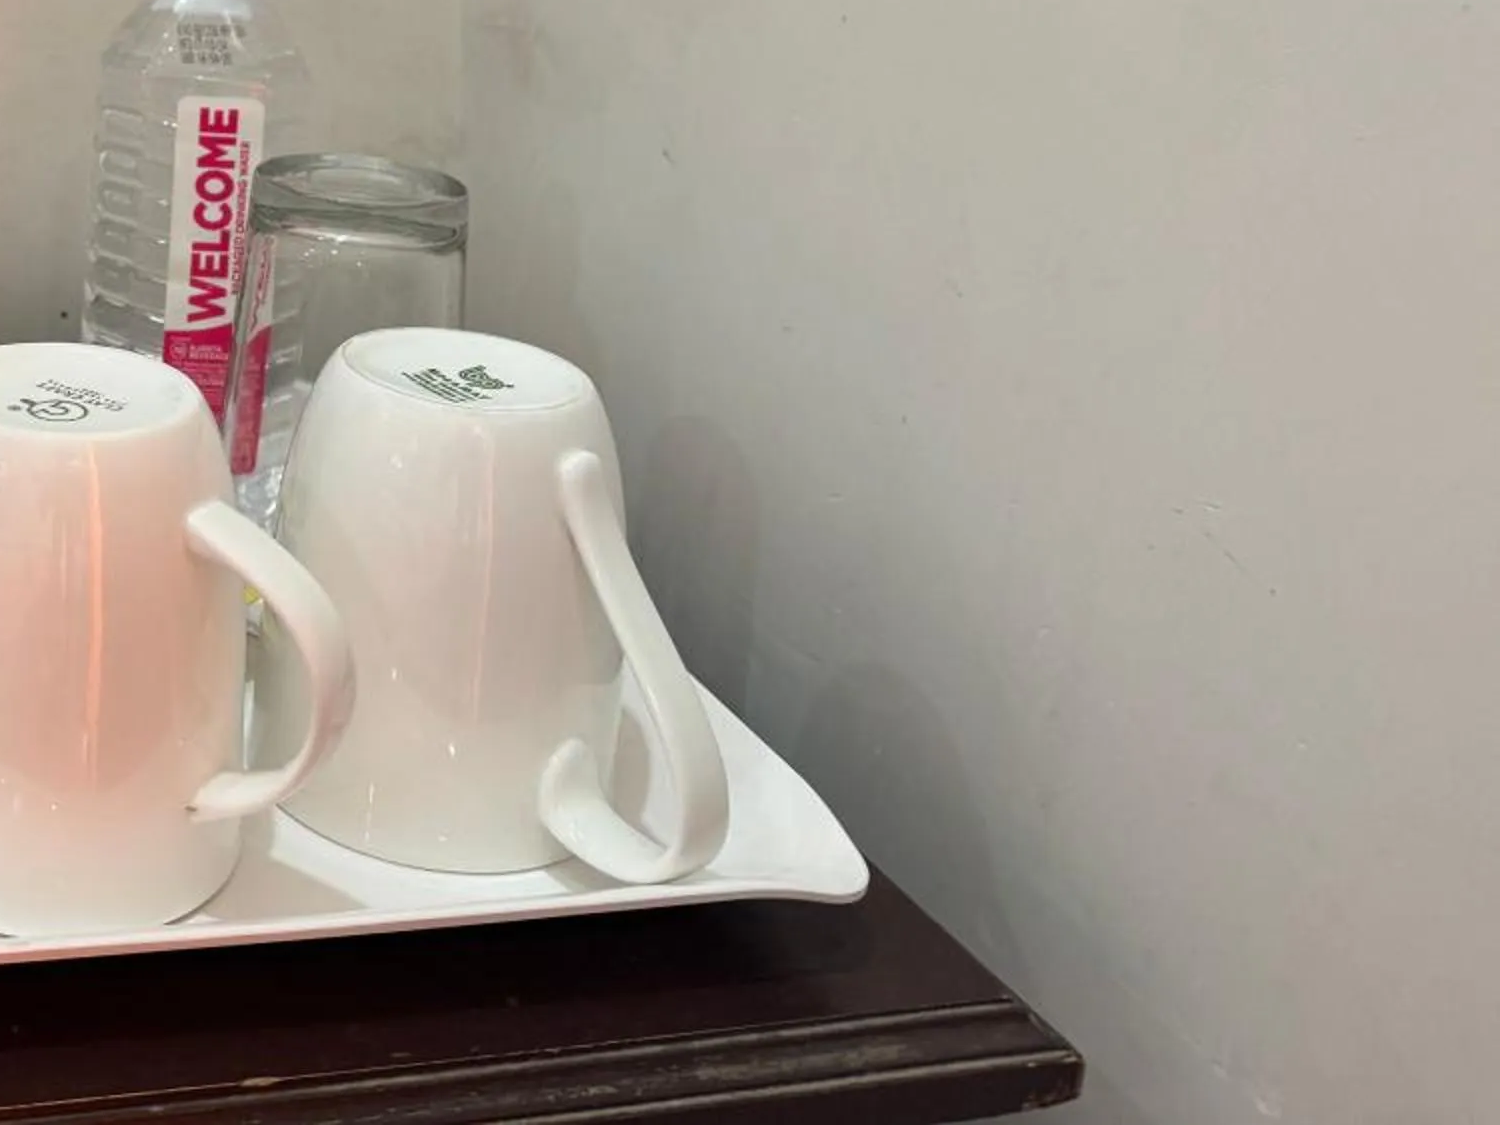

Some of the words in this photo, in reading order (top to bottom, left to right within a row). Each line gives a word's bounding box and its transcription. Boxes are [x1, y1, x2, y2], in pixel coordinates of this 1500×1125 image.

[239, 140, 251, 177] WATER
[186, 106, 240, 324] WELCOME
[235, 179, 249, 235] DRINKING
